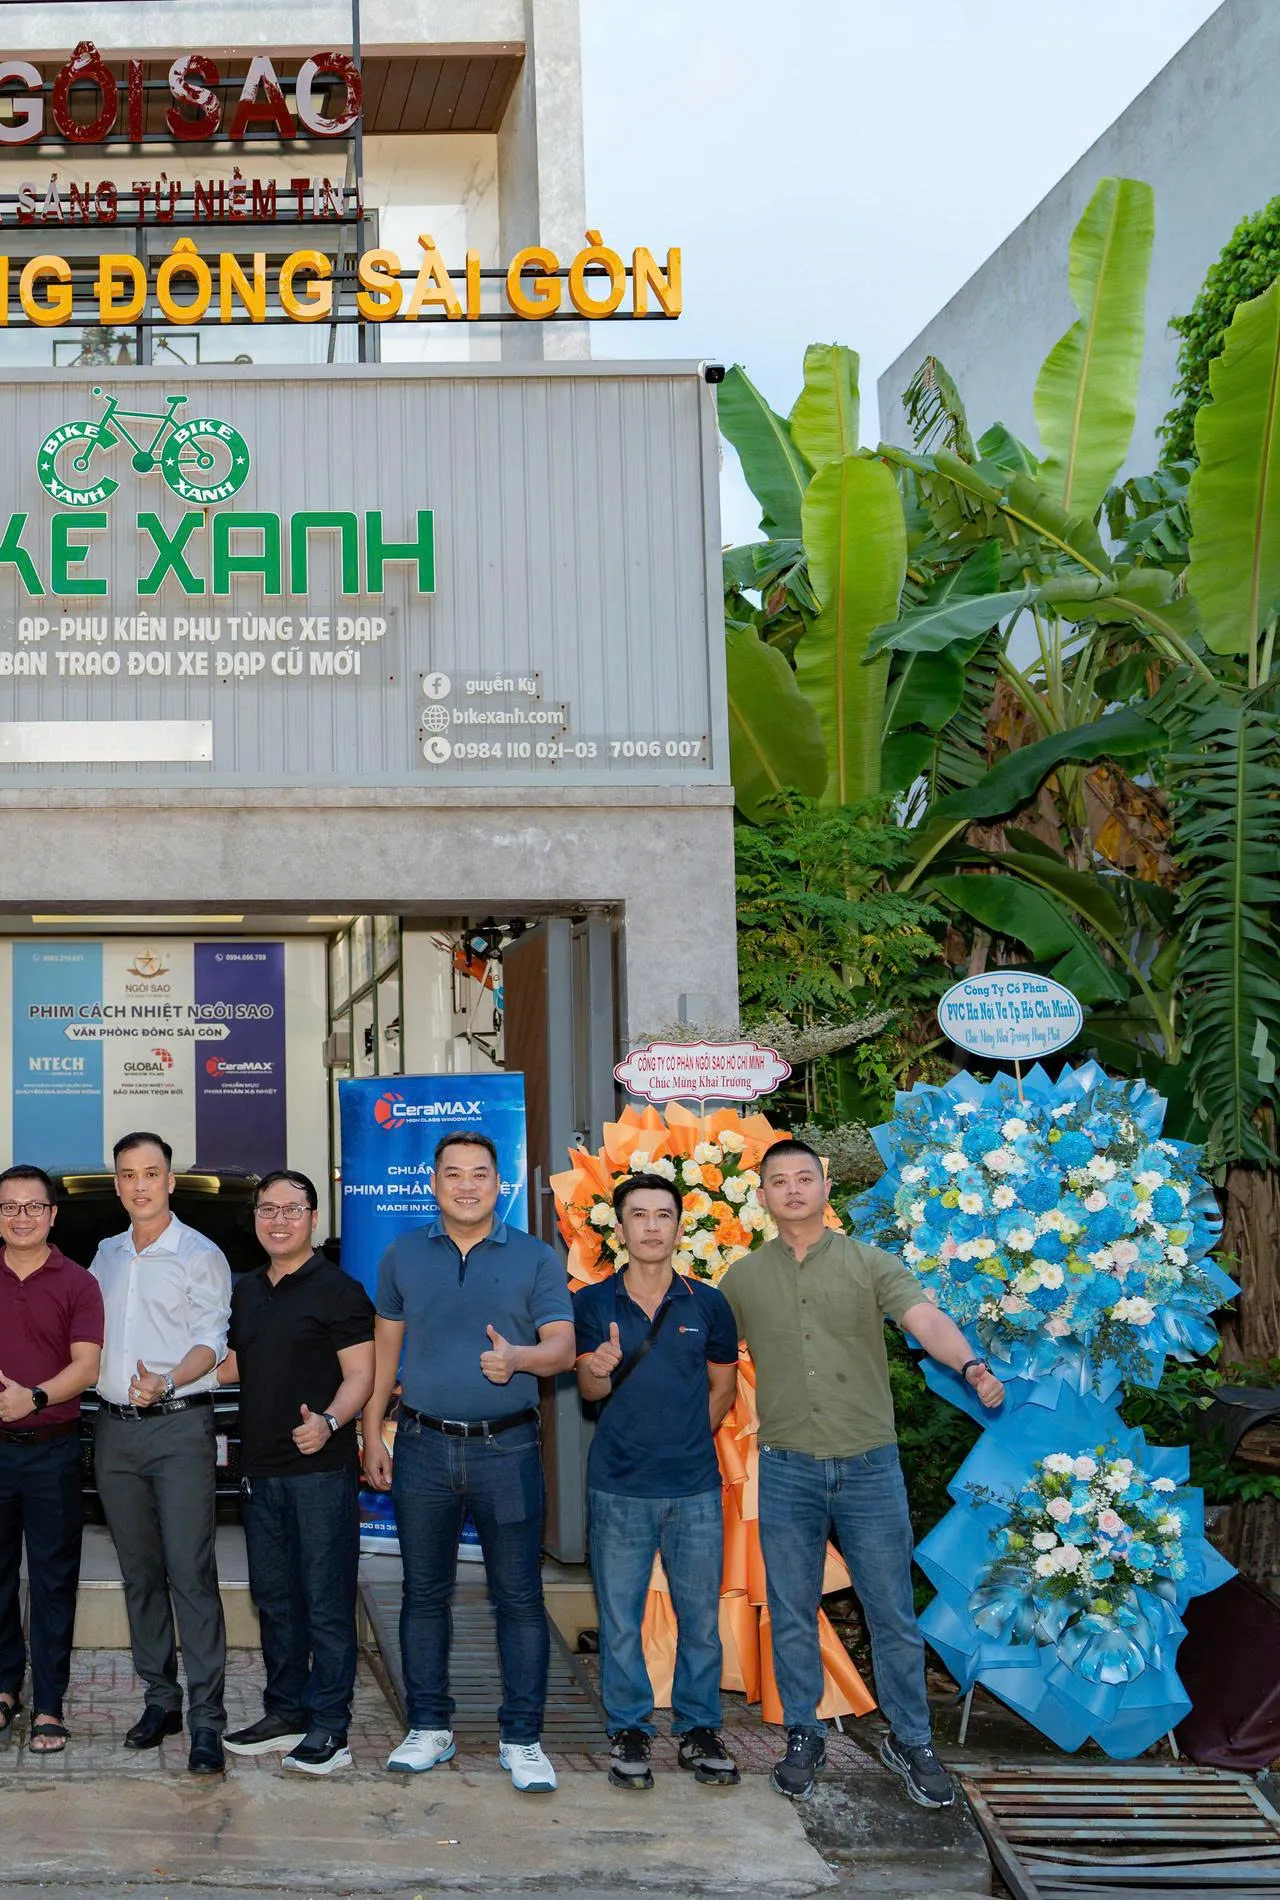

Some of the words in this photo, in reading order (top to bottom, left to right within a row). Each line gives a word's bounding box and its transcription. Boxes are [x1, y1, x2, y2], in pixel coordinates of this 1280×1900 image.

[165, 52, 363, 140] SAO
[16, 172, 118, 223] SÁNG
[291, 177, 345, 220] TIN
[93, 237, 333, 326] ĐÔNG
[356, 234, 481, 323] SÀI
[505, 229, 682, 321] GÒN
[42, 423, 101, 456] BIKE
[172, 420, 236, 445] BIKE
[44, 478, 106, 505] XANH
[172, 477, 236, 502] XANH
[135, 509, 437, 598] XANH
[16, 616, 108, 646] ẠP-PHỤ
[173, 616, 221, 645] PHỤ
[227, 611, 293, 642] TÙNG
[299, 616, 331, 641] XE
[336, 616, 387, 647] ĐẠP
[55, 650, 121, 676] TRAO
[177, 650, 209, 676] XE
[215, 650, 266, 681] ĐẠP
[271, 646, 303, 676] CŨ
[309, 644, 361, 676] MỚI
[453, 742, 502, 759] 0984
[507, 743, 531, 758] 110
[610, 741, 662, 757] 7006
[665, 741, 701, 757] 007
[125, 983, 148, 993] NGÔI
[151, 984, 171, 993] SAO
[991, 984, 1004, 997] Ty
[28, 1004, 74, 1019] PHIM
[78, 1002, 126, 1019] CÁCH
[131, 1002, 183, 1022] NHIỆT
[187, 1001, 232, 1019] NGÔI
[236, 1004, 274, 1019] SAO
[946, 1003, 965, 1021] PVC
[1008, 1001, 1020, 1024] Tp
[1052, 999, 1075, 1019] Minh
[73, 1026, 96, 1037] VĂN
[99, 1026, 139, 1037] PHÒNG
[141, 1026, 174, 1037] ĐÔNG
[177, 1026, 195, 1037] SÀI
[198, 1026, 222, 1037] GÒN
[28, 1056, 85, 1071] NTECH
[123, 1062, 165, 1072] GLOBAL
[217, 1062, 272, 1071] CeraMAX
[637, 1053, 656, 1072] CÔNG
[657, 1056, 665, 1071] TY
[712, 1055, 725, 1070] SAO
[749, 1055, 765, 1070] MINH
[649, 1075, 671, 1089] Chúc
[672, 1075, 697, 1091] Mừng
[698, 1075, 719, 1088] Khai
[721, 1075, 752, 1090] Trương
[392, 1100, 482, 1117] CeraMAX
[387, 1161, 435, 1176] CHUẨN
[344, 1184, 384, 1196] PHIM
[387, 1181, 435, 1196] PHẢN
[376, 1204, 408, 1212] MADE
[409, 1204, 421, 1212] IN
